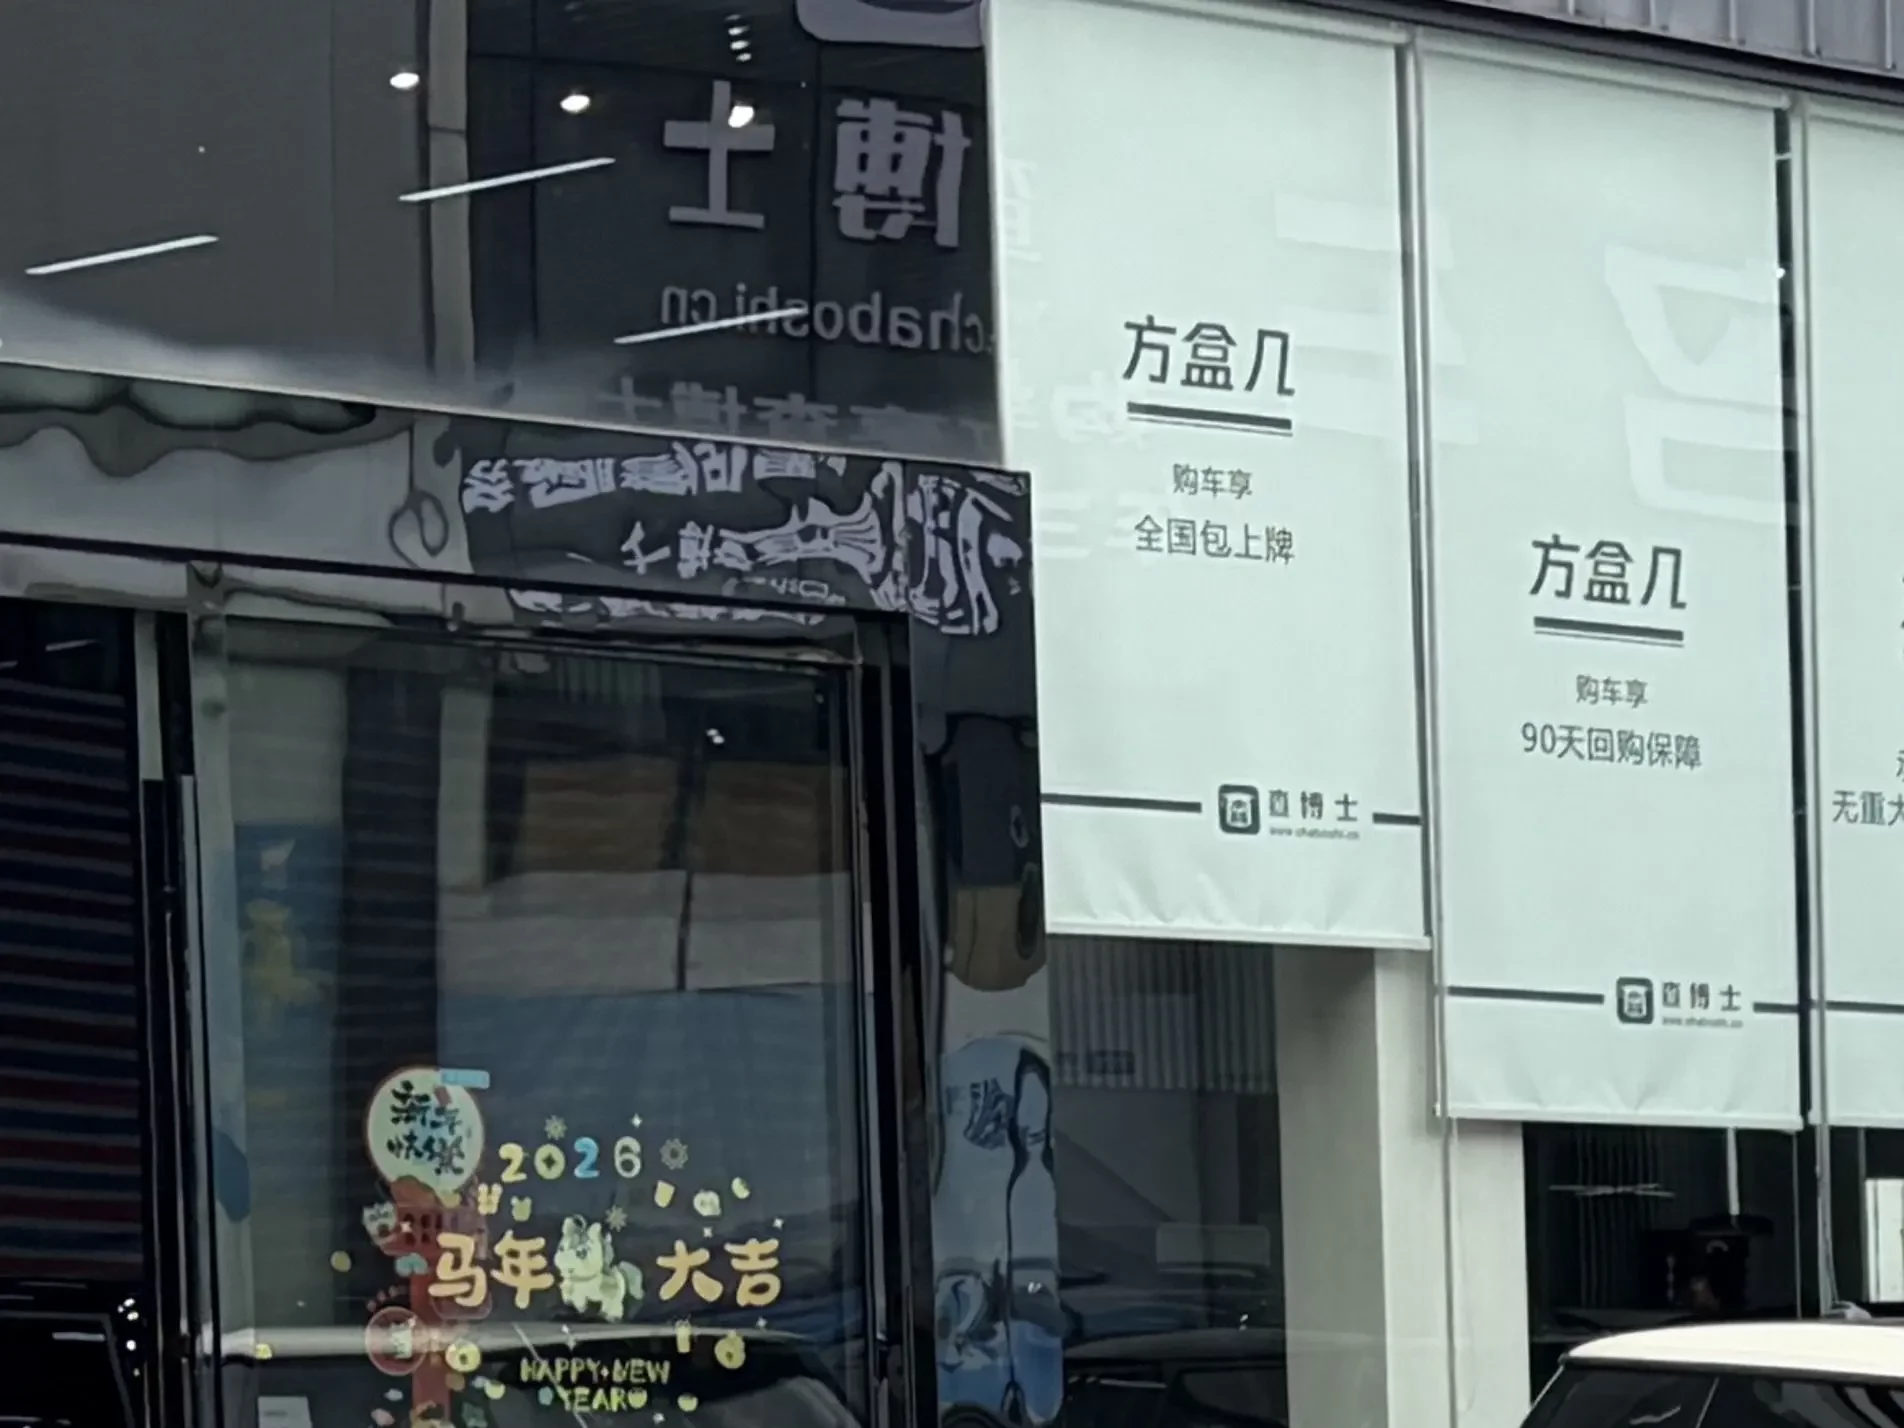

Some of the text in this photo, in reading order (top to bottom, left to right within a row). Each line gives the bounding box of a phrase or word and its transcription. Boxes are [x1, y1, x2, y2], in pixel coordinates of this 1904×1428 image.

[1122, 314, 1296, 397] 方盒几
[1172, 463, 1253, 500] 购车享
[1134, 514, 1295, 566] 全国包上牌
[1528, 533, 1687, 610] 方盒几
[1575, 674, 1649, 709] 购车享
[1520, 721, 1702, 771] 90天回购保障
[499, 1136, 642, 1184] 2026
[428, 1230, 781, 1309] 马年 大吉
[520, 1357, 671, 1384] HAPPY NEW
[557, 1386, 628, 1412] YEAR
